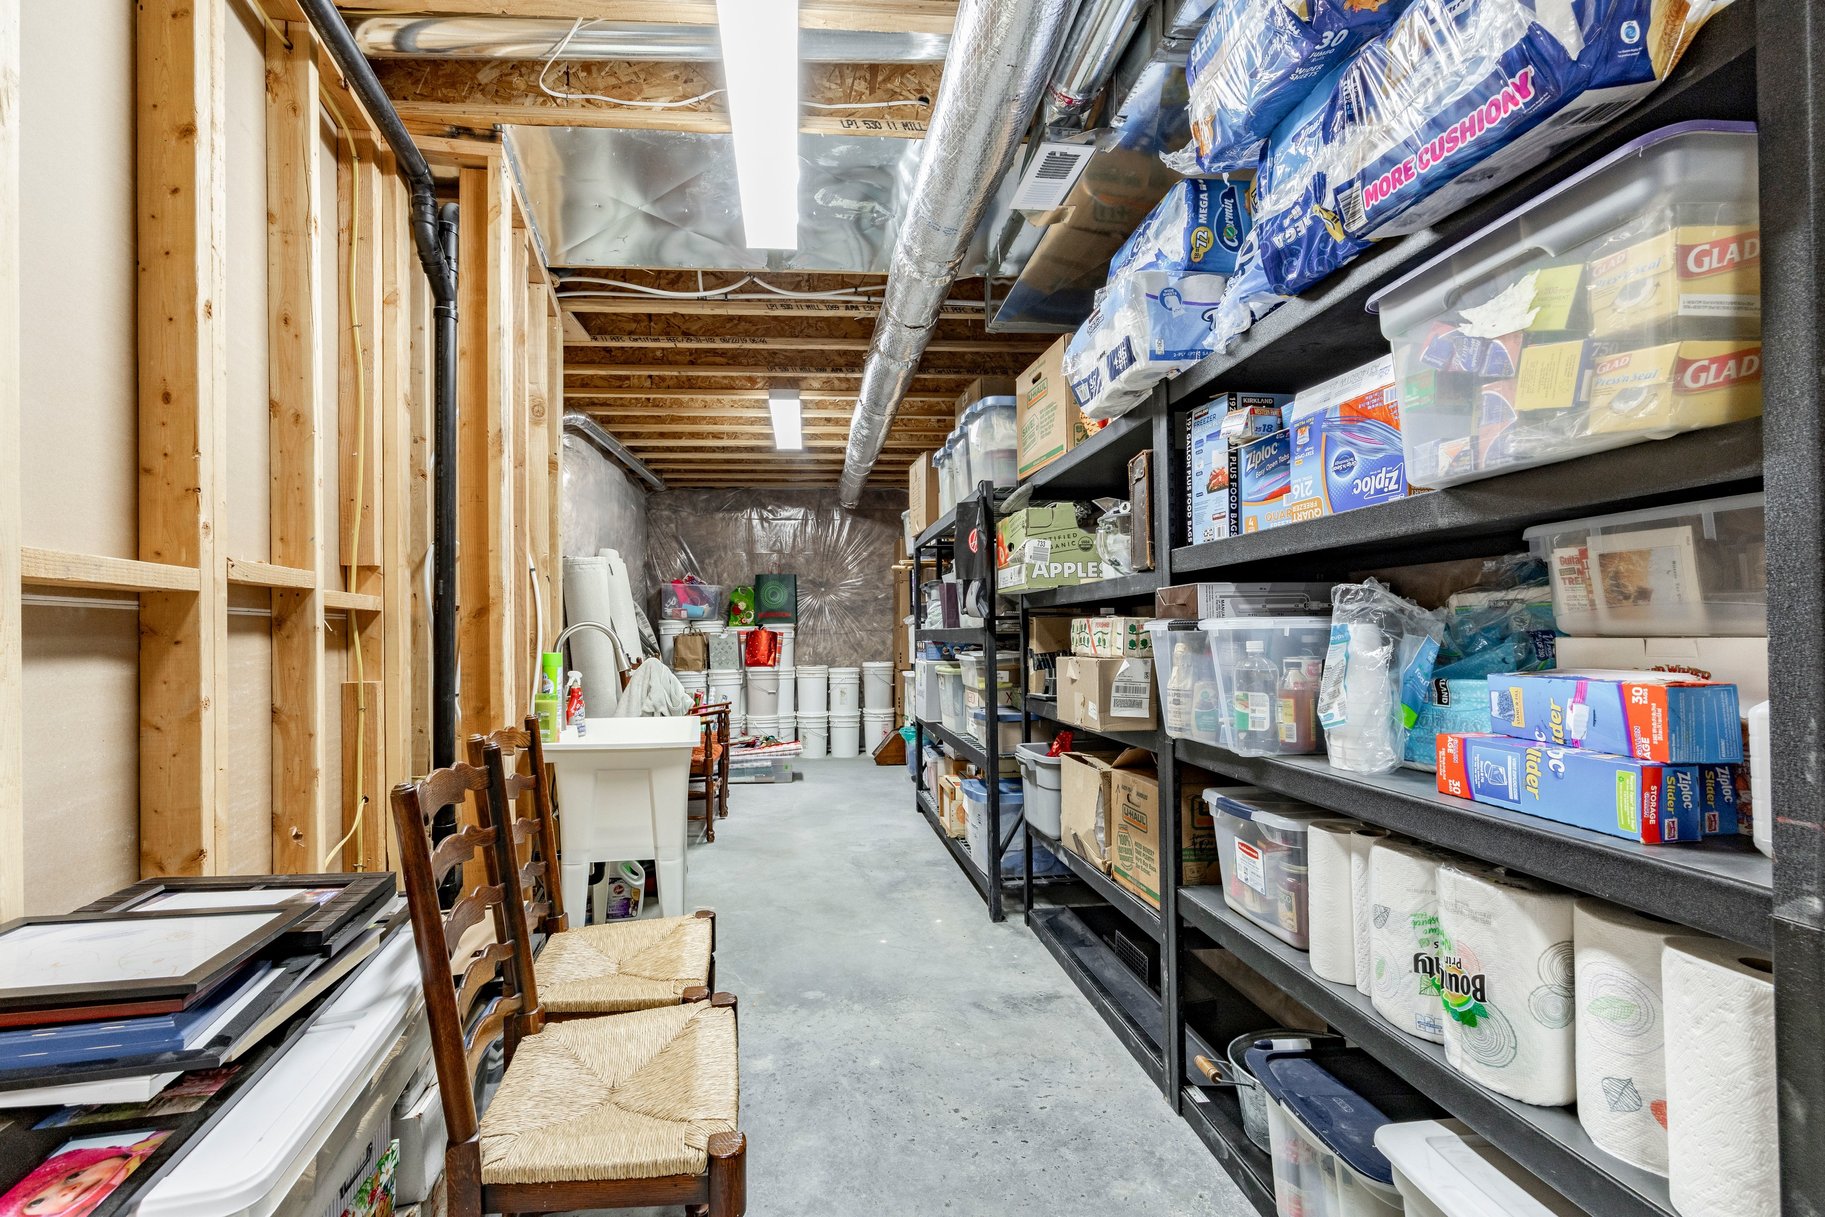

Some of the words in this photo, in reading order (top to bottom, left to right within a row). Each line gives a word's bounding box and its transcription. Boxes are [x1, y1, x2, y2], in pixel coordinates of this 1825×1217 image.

[1315, 30, 1348, 49] 30
[1310, 49, 1335, 58] JUMBO
[1289, 71, 1318, 81] SHEETS
[1295, 64, 1324, 74] WIDER
[841, 119, 858, 129] LPI
[863, 120, 882, 129] 530
[902, 122, 928, 131] MILL
[1363, 156, 1416, 209] MORE
[1417, 70, 1533, 173] CUSHIONY
[1198, 192, 1208, 224] MEGA
[1223, 198, 1239, 247] Crmin
[1196, 231, 1208, 248] 72
[1592, 253, 1627, 278] GLAD
[1687, 239, 1760, 273] GLAD
[1595, 355, 1630, 375] GLAD
[1683, 354, 1760, 389] GLAD
[1027, 380, 1047, 402] U-HAUL
[1193, 414, 1217, 428] FREEZER
[1262, 423, 1273, 433] 18
[1246, 441, 1278, 473] Ziploc
[1255, 467, 1266, 479] Easy
[1265, 460, 1278, 471] Open
[1278, 453, 1290, 463] Tabs
[1229, 456, 1237, 479] PLUS
[1291, 480, 1313, 499] 216
[1352, 466, 1399, 495] Ziploc
[1230, 482, 1238, 510] FOOD
[1292, 500, 1318, 511] FREEZER
[1230, 513, 1239, 536] BAGS
[1248, 517, 1254, 526] 4
[1264, 508, 1292, 522] QUAR
[1291, 507, 1322, 523] QUART
[1037, 540, 1046, 548] 733
[1047, 532, 1078, 541] TIFIED
[1050, 541, 1076, 550] ANIC
[1559, 556, 1580, 566] Guita
[1438, 678, 1449, 704] LAND
[1631, 686, 1642, 705] 30
[1549, 697, 1565, 745] ider
[1452, 779, 1461, 795] 30
[1677, 772, 1693, 809] Ziploc
[1704, 770, 1715, 808] Slider
[1715, 766, 1733, 803] Ziploc
[1649, 785, 1658, 825] STORAGE
[1666, 776, 1676, 814] Slider
[1123, 806, 1146, 826] U-HAUL
